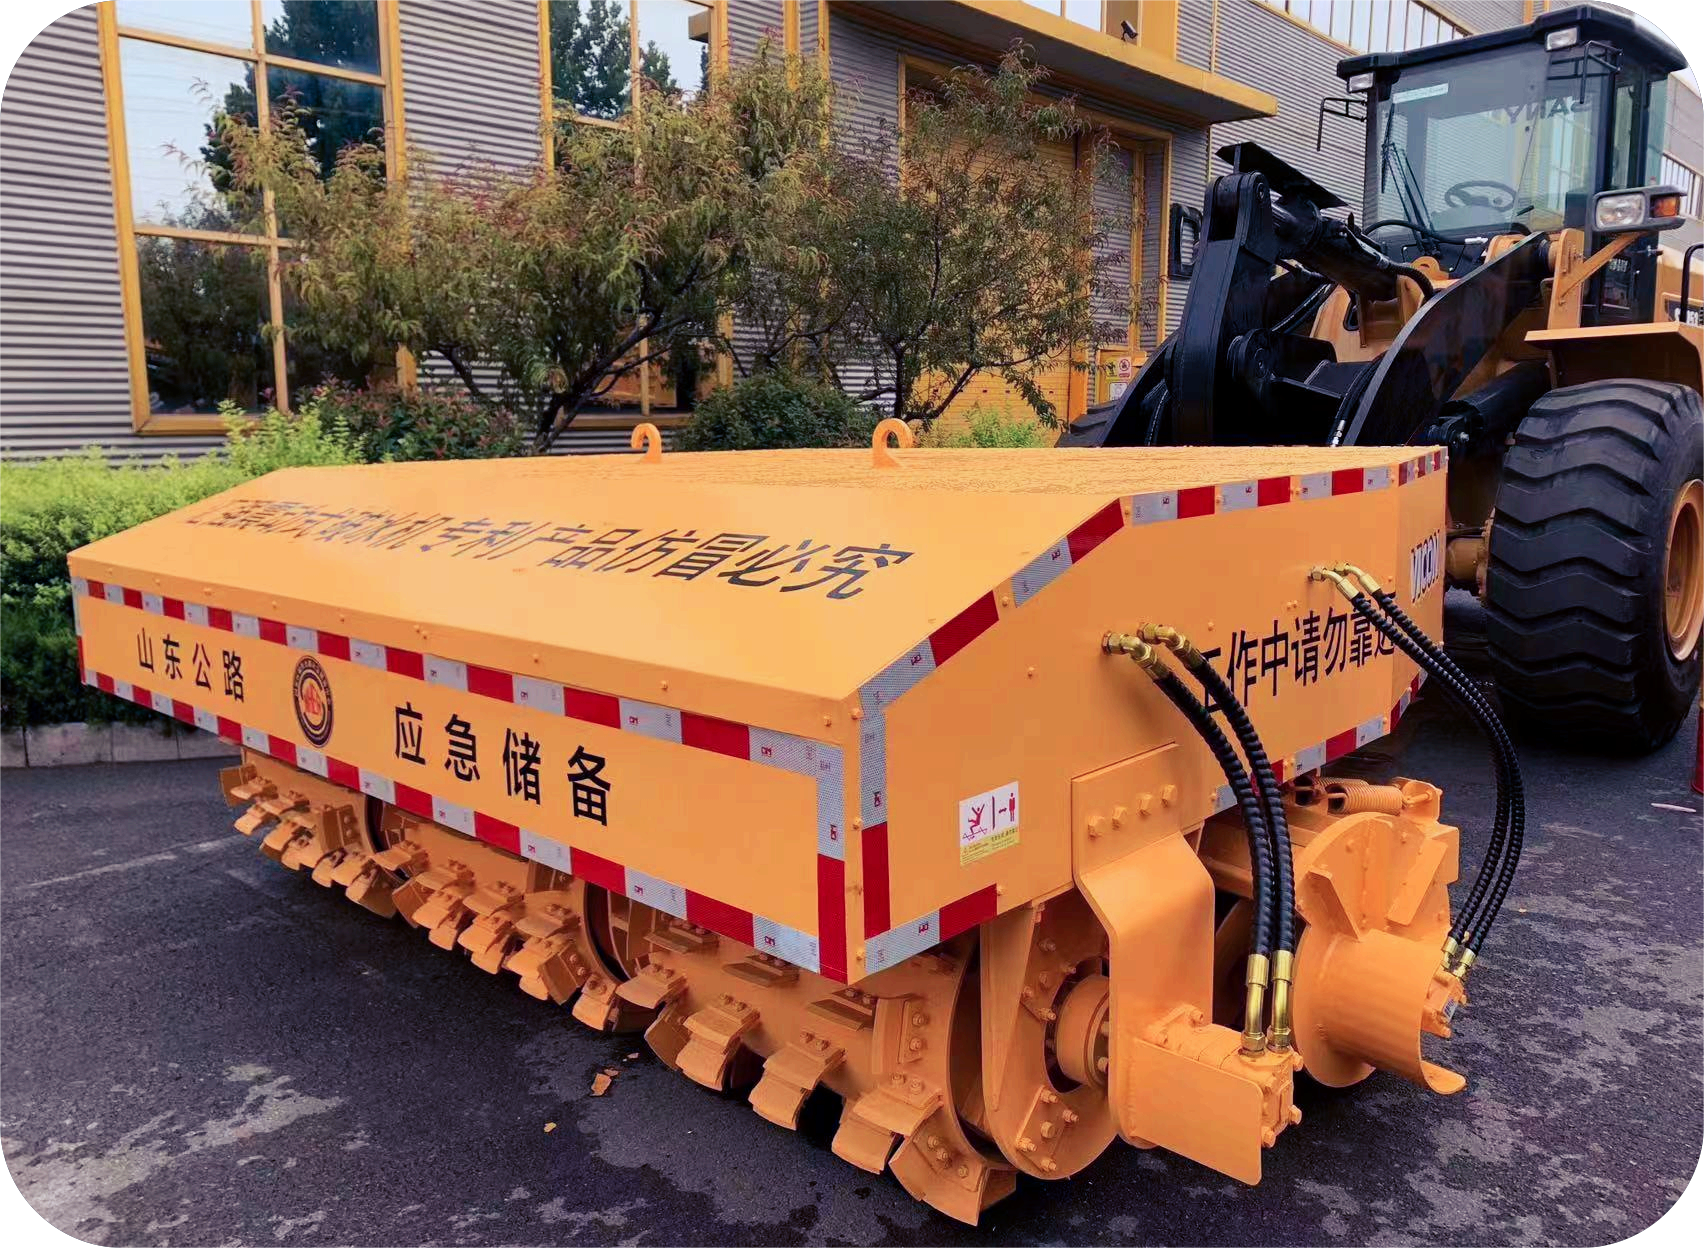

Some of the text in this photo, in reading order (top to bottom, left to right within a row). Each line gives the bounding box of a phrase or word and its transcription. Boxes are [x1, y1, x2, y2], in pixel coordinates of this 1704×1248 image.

[137, 627, 244, 703] 山东公路
[395, 701, 612, 826] 应急储备
